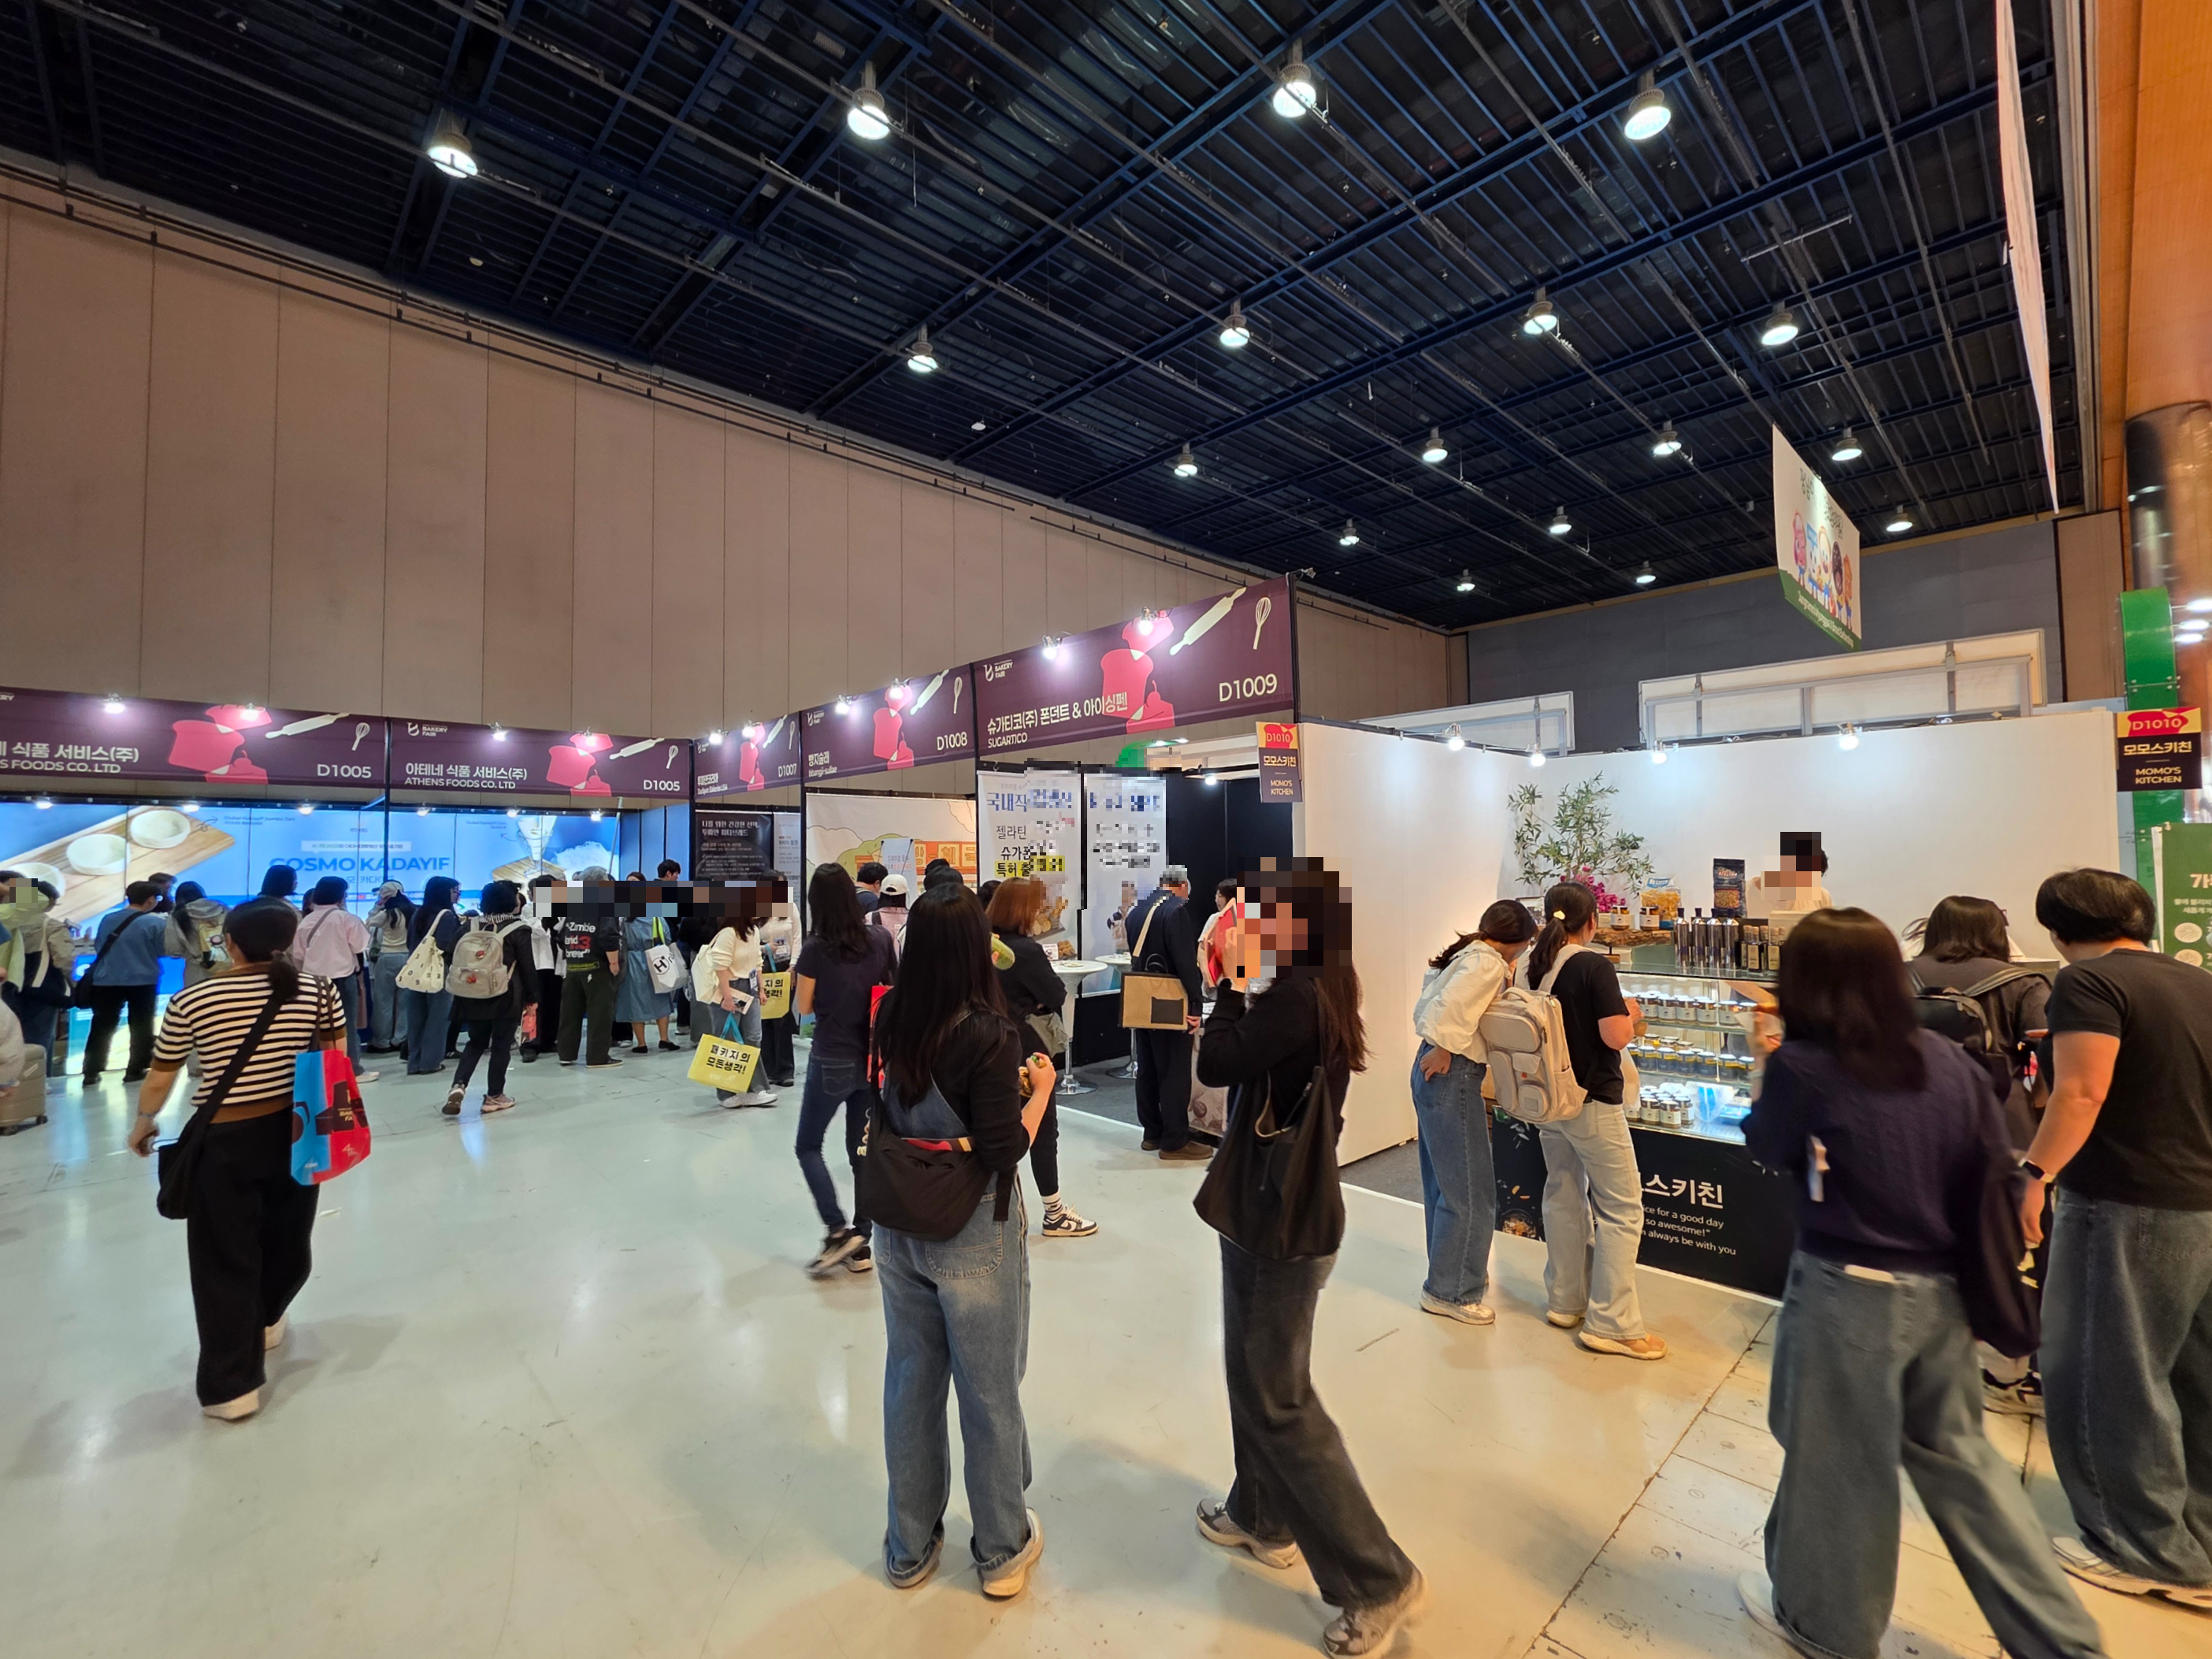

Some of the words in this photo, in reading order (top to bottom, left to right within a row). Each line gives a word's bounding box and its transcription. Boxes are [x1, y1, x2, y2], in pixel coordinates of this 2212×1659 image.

[995, 662, 1013, 672] BAKERY
[1219, 673, 1278, 702] D1009
[987, 709, 1038, 735] 슈가티코(주)
[1040, 703, 1071, 726] 폰던트
[1072, 701, 1082, 718] &
[1083, 692, 1128, 717] 아이싱펜
[2132, 718, 2182, 731] D1010
[937, 732, 967, 751] D1008
[988, 732, 1028, 748] SUGARTICO
[1266, 733, 1291, 743] D1010
[12, 742, 50, 759] 식품
[54, 744, 139, 763] 서비스(주)
[2124, 740, 2192, 755] 모모스키친
[12, 759, 65, 771] FOODS
[66, 762, 92, 773] CO.
[94, 763, 121, 774] LTD
[1263, 755, 1297, 767] 모모스키친
[317, 763, 372, 779] D1005
[406, 763, 444, 776] 아테네
[446, 764, 471, 778] 식품
[473, 766, 528, 781] 서비스(주)
[778, 763, 797, 778] D1007
[2136, 766, 2181, 776] MOMO'S
[404, 777, 445, 787] ATHENS
[446, 778, 480, 788] FOODS
[481, 780, 497, 789] CO.
[498, 781, 516, 789] LTD
[643, 779, 681, 792] D1005
[2135, 775, 2182, 785] KITCHEN
[997, 825, 1026, 840] 젤라틴
[269, 857, 355, 871] COSMO
[360, 857, 450, 871] KADAYIF
[997, 863, 1018, 877] 특허
[706, 1056, 746, 1074] 모든생각!
[1642, 1174, 1724, 1210] 스키친
[1657, 1208, 1670, 1217] for
[1679, 1213, 1705, 1226] good
[1705, 1218, 1724, 1230] day
[1648, 1229, 1680, 1244] always
[1681, 1234, 1694, 1246] be
[1695, 1238, 1717, 1252] with
[1717, 1245, 1736, 1256] you
